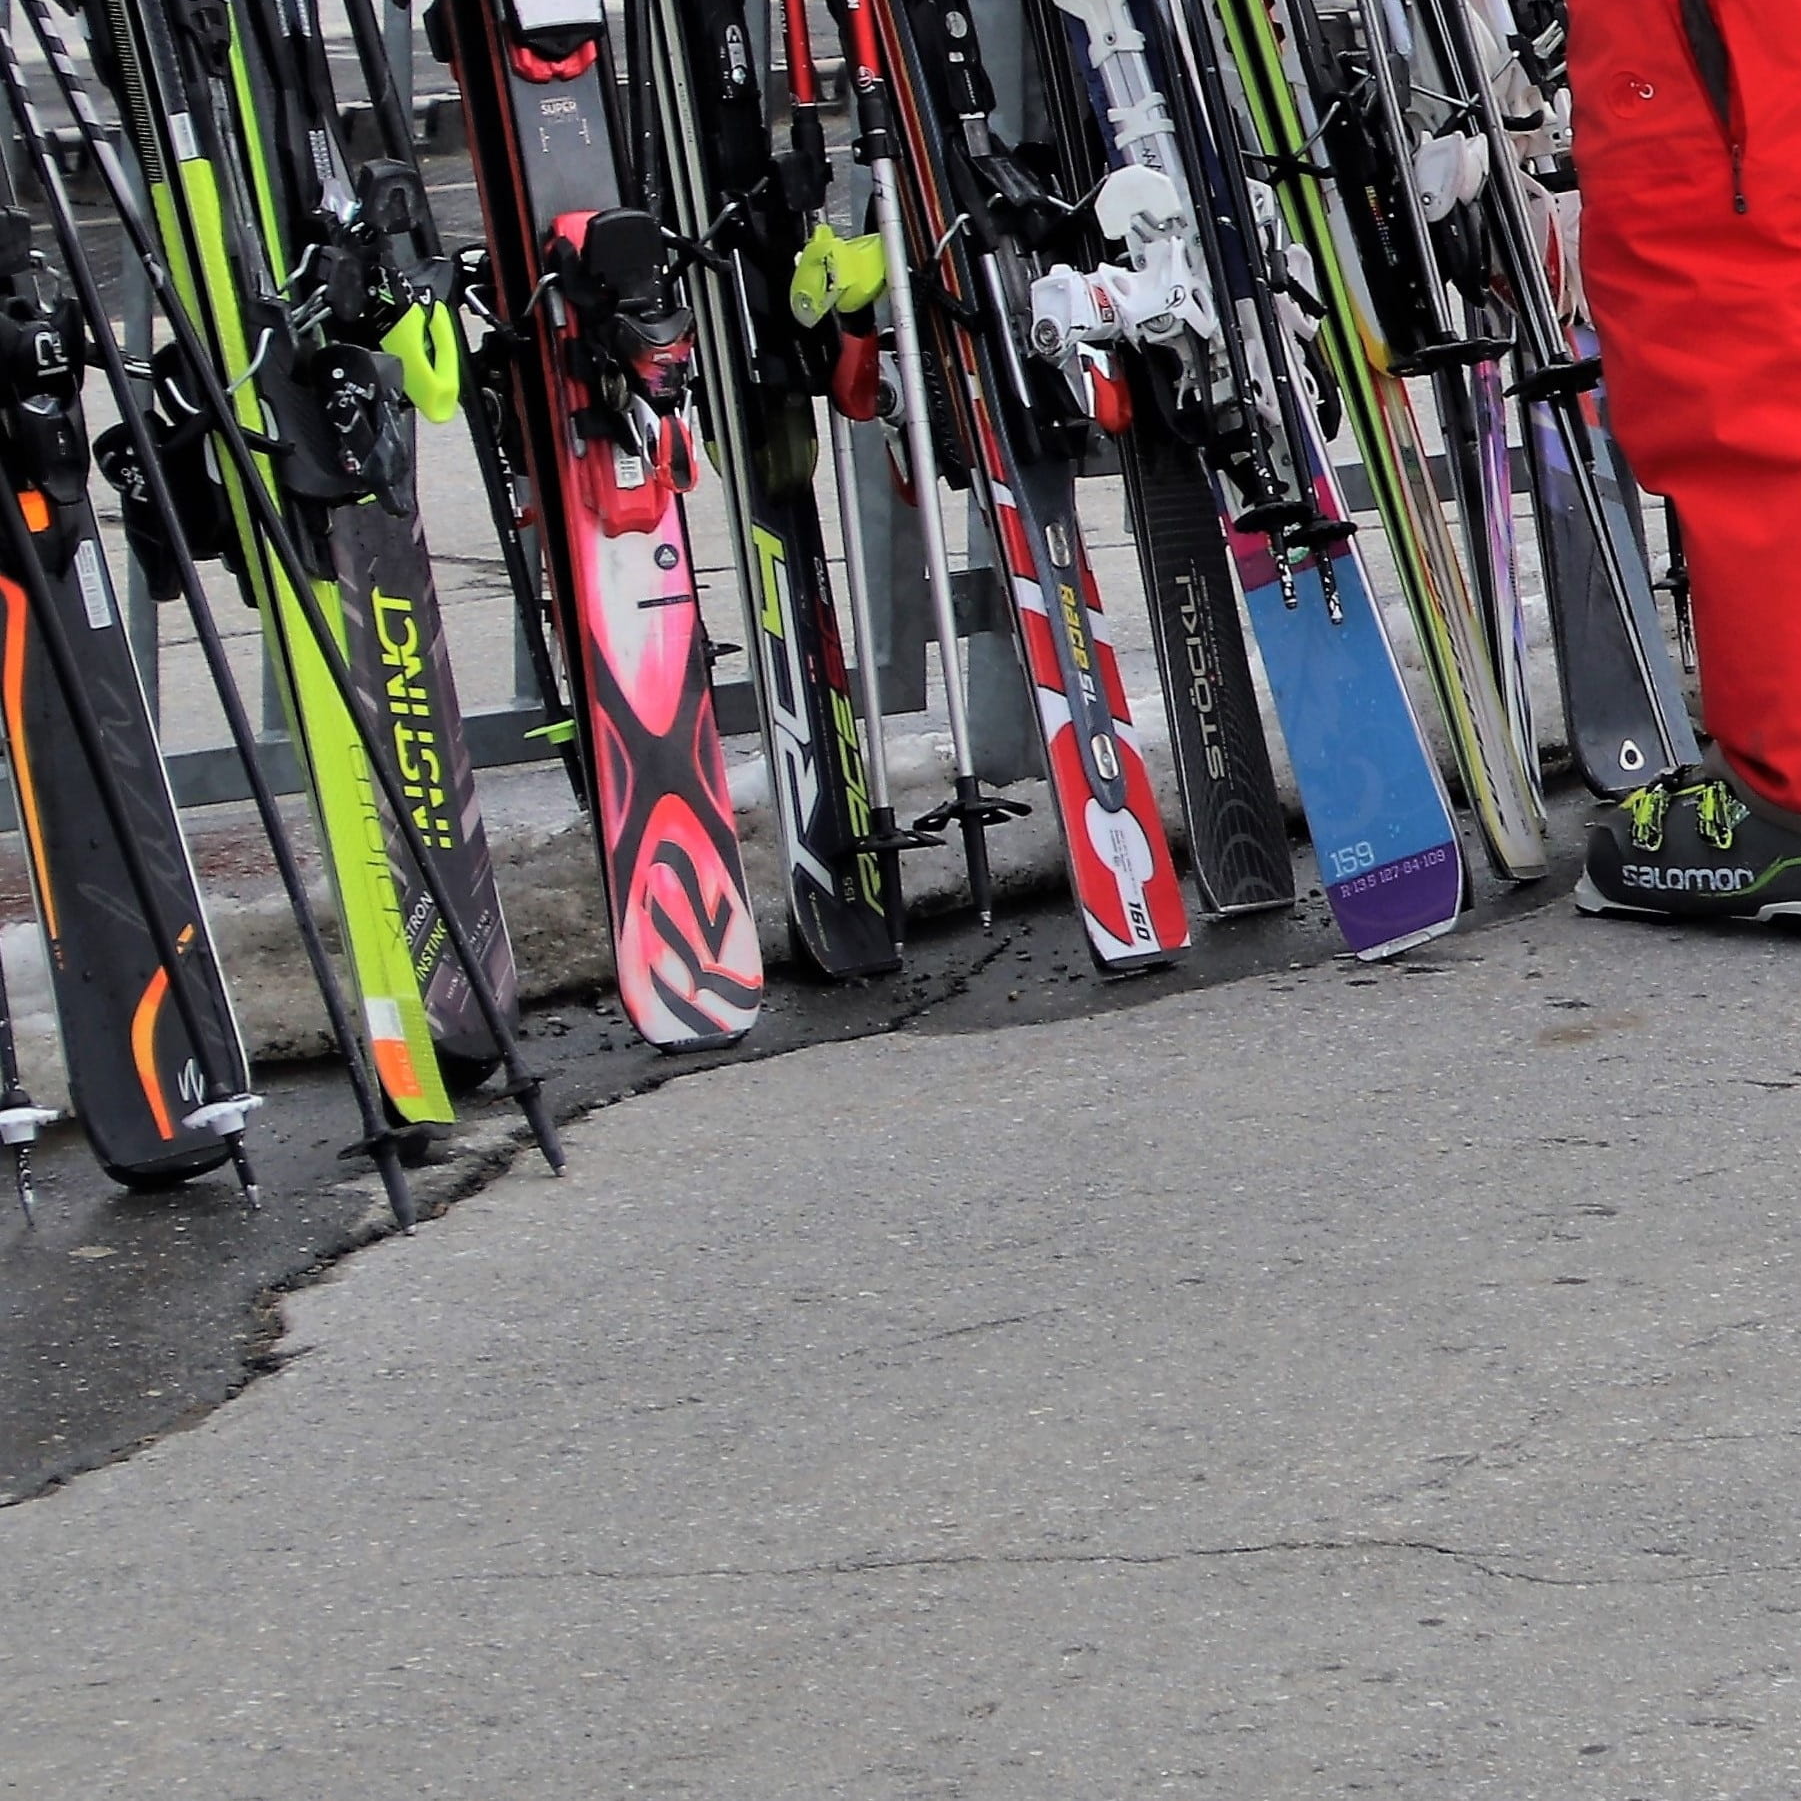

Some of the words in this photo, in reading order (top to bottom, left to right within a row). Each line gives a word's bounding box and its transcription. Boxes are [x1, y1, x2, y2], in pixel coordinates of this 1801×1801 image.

[1175, 574, 1225, 782] STÖCKLI
[371, 585, 453, 851] INSTINCT
[1329, 840, 1376, 878] 159
[1621, 863, 1754, 892] salomon
[405, 889, 436, 951] STRON
[416, 915, 449, 983] INSTINC
[1129, 899, 1151, 942] 160
